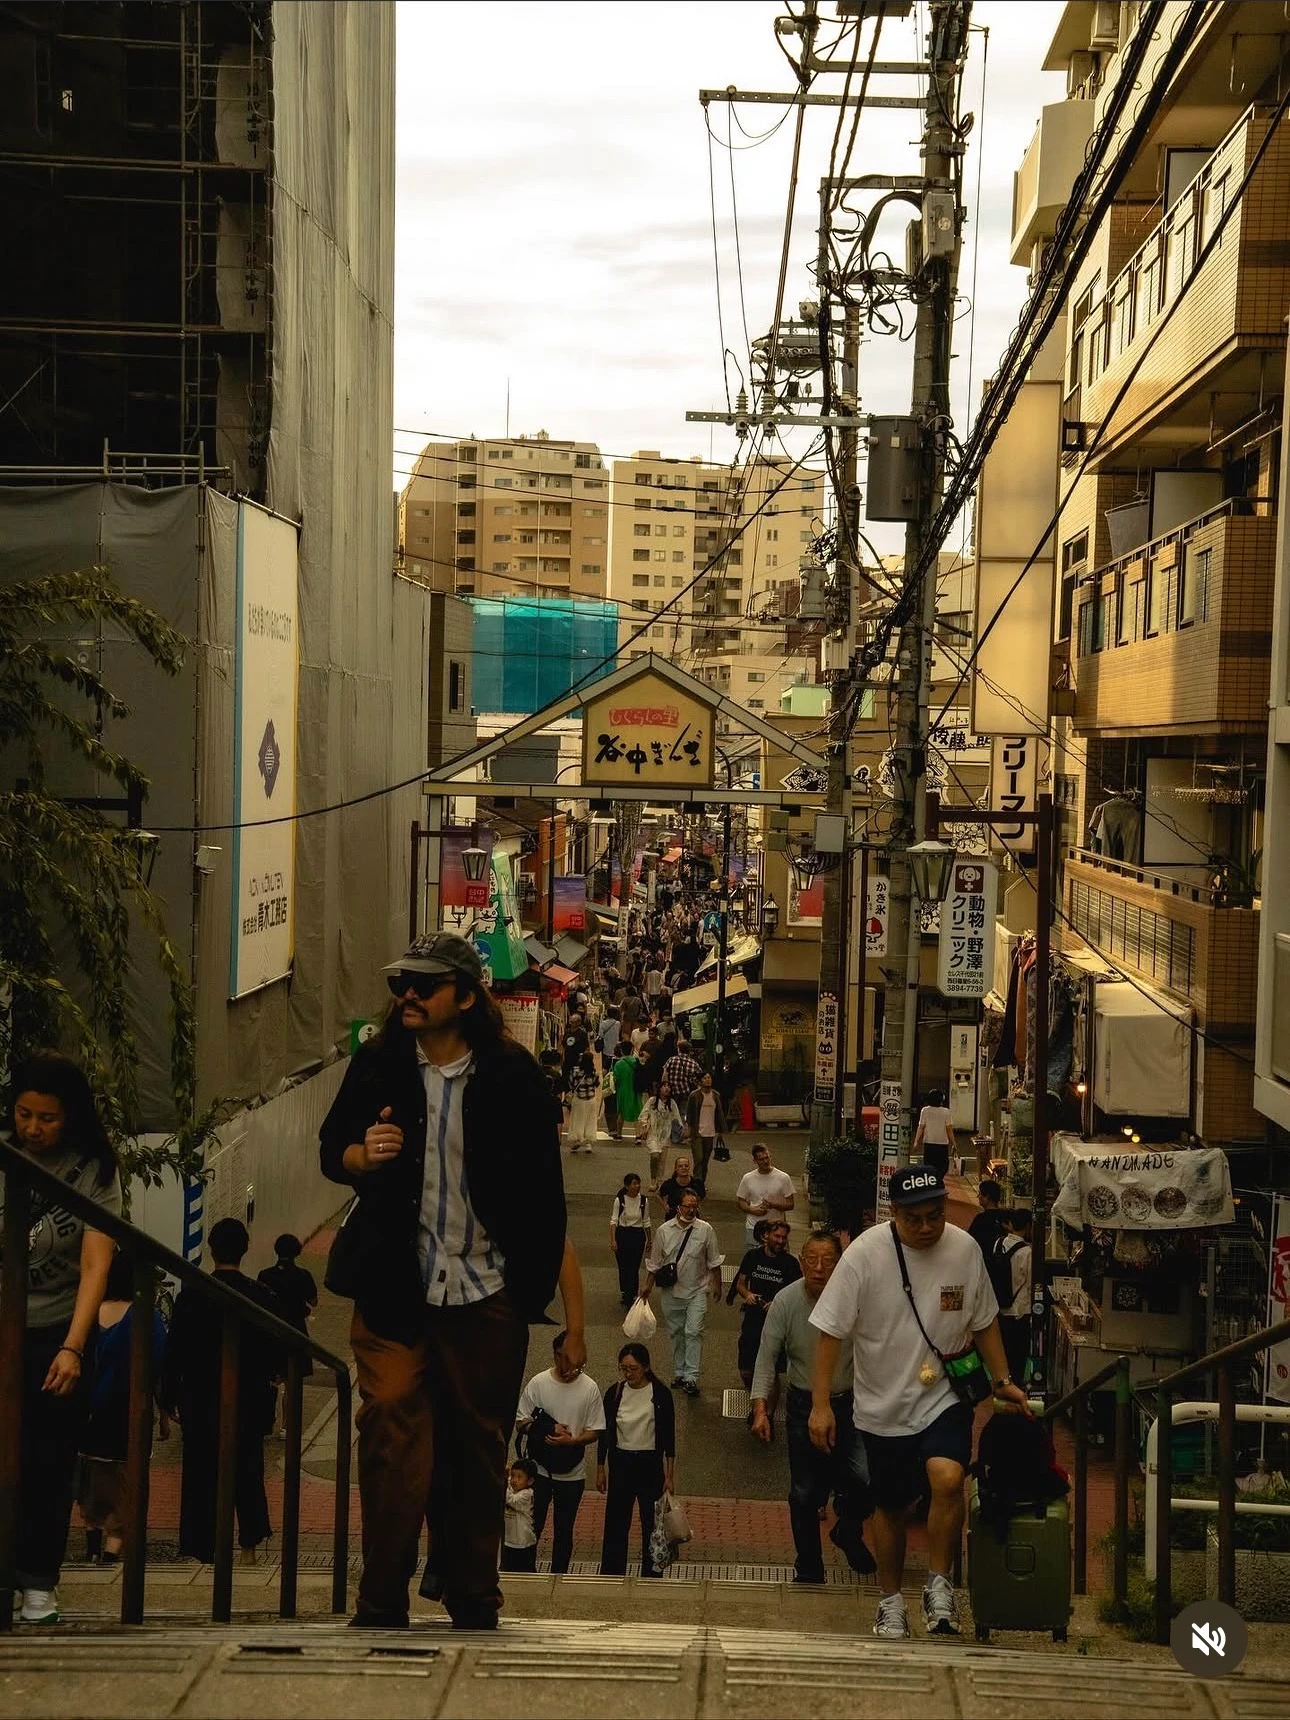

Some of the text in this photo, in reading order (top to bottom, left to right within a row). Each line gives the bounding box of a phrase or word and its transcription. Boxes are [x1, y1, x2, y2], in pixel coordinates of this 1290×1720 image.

[595, 722, 704, 775] 谷中ぎんざ
[876, 882, 887, 915] かき氷
[950, 895, 967, 968] クリニック
[967, 895, 985, 969] 動物・野澤
[947, 984, 984, 993] 3894-7739
[825, 1004, 836, 1039] 猫雑貨
[902, 1172, 938, 1191] ciele
